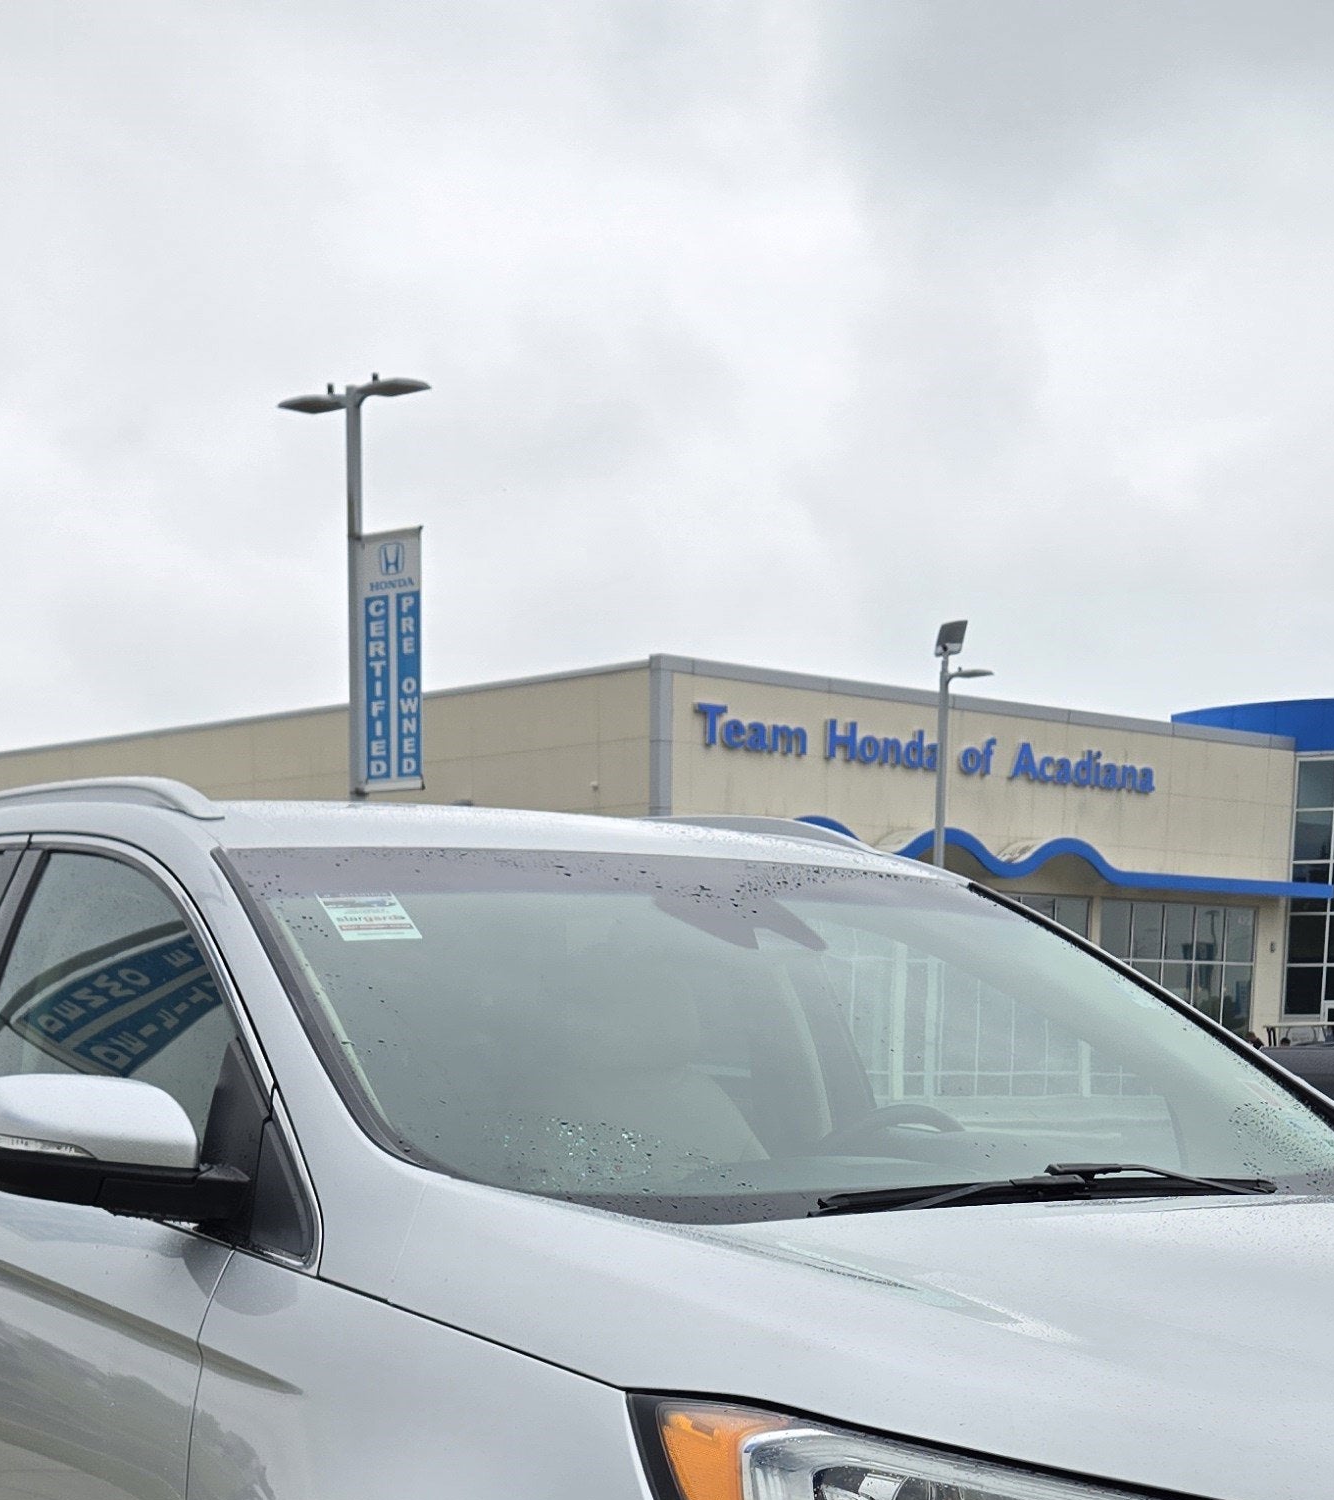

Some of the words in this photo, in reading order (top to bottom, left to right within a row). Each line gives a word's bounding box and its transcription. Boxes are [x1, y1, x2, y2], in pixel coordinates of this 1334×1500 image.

[369, 577, 415, 592] HONDA
[400, 597, 416, 655] PRE
[368, 599, 389, 777] CERTIFIED
[399, 676, 419, 775] OWNED
[695, 702, 807, 756] Team
[825, 718, 938, 771] Honda
[959, 738, 997, 776] of
[1009, 742, 1155, 794] Acadiana
